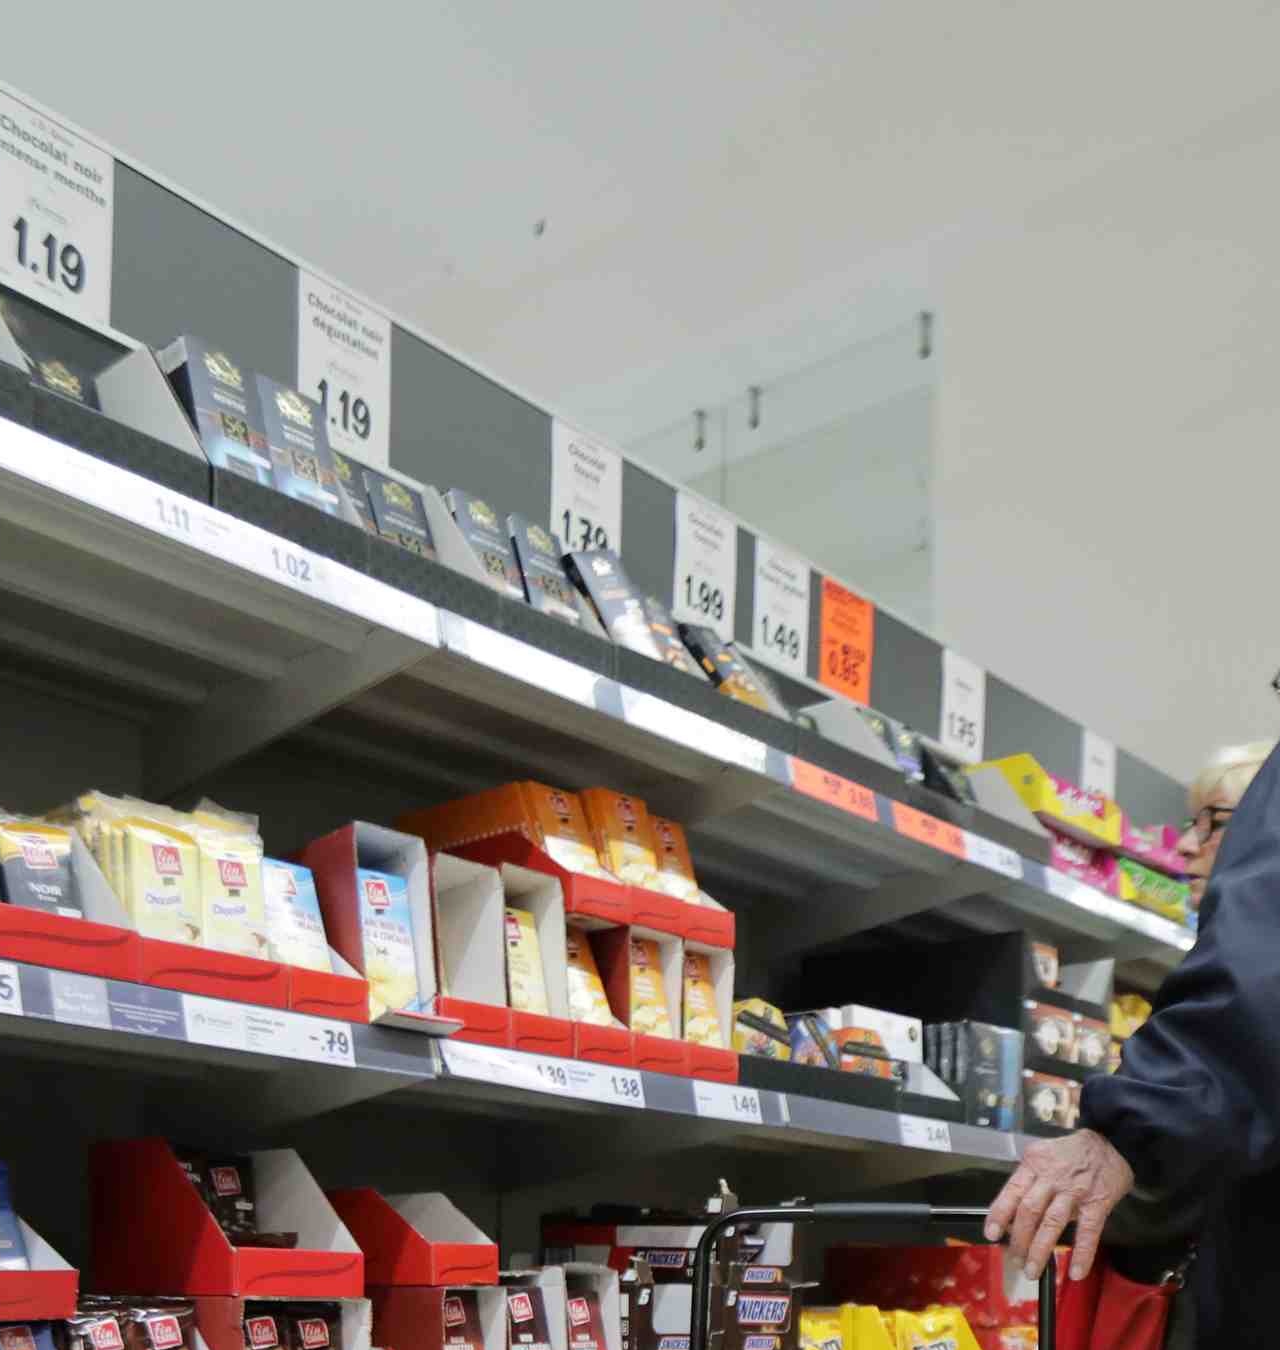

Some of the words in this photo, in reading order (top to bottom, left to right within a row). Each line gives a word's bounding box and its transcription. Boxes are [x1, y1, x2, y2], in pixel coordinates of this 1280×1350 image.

[13, 217, 85, 293] 1.19
[318, 378, 370, 439] 1.19
[156, 498, 190, 532] 1.11
[272, 547, 312, 583] 1.02
[308, 1029, 349, 1054] -.79
